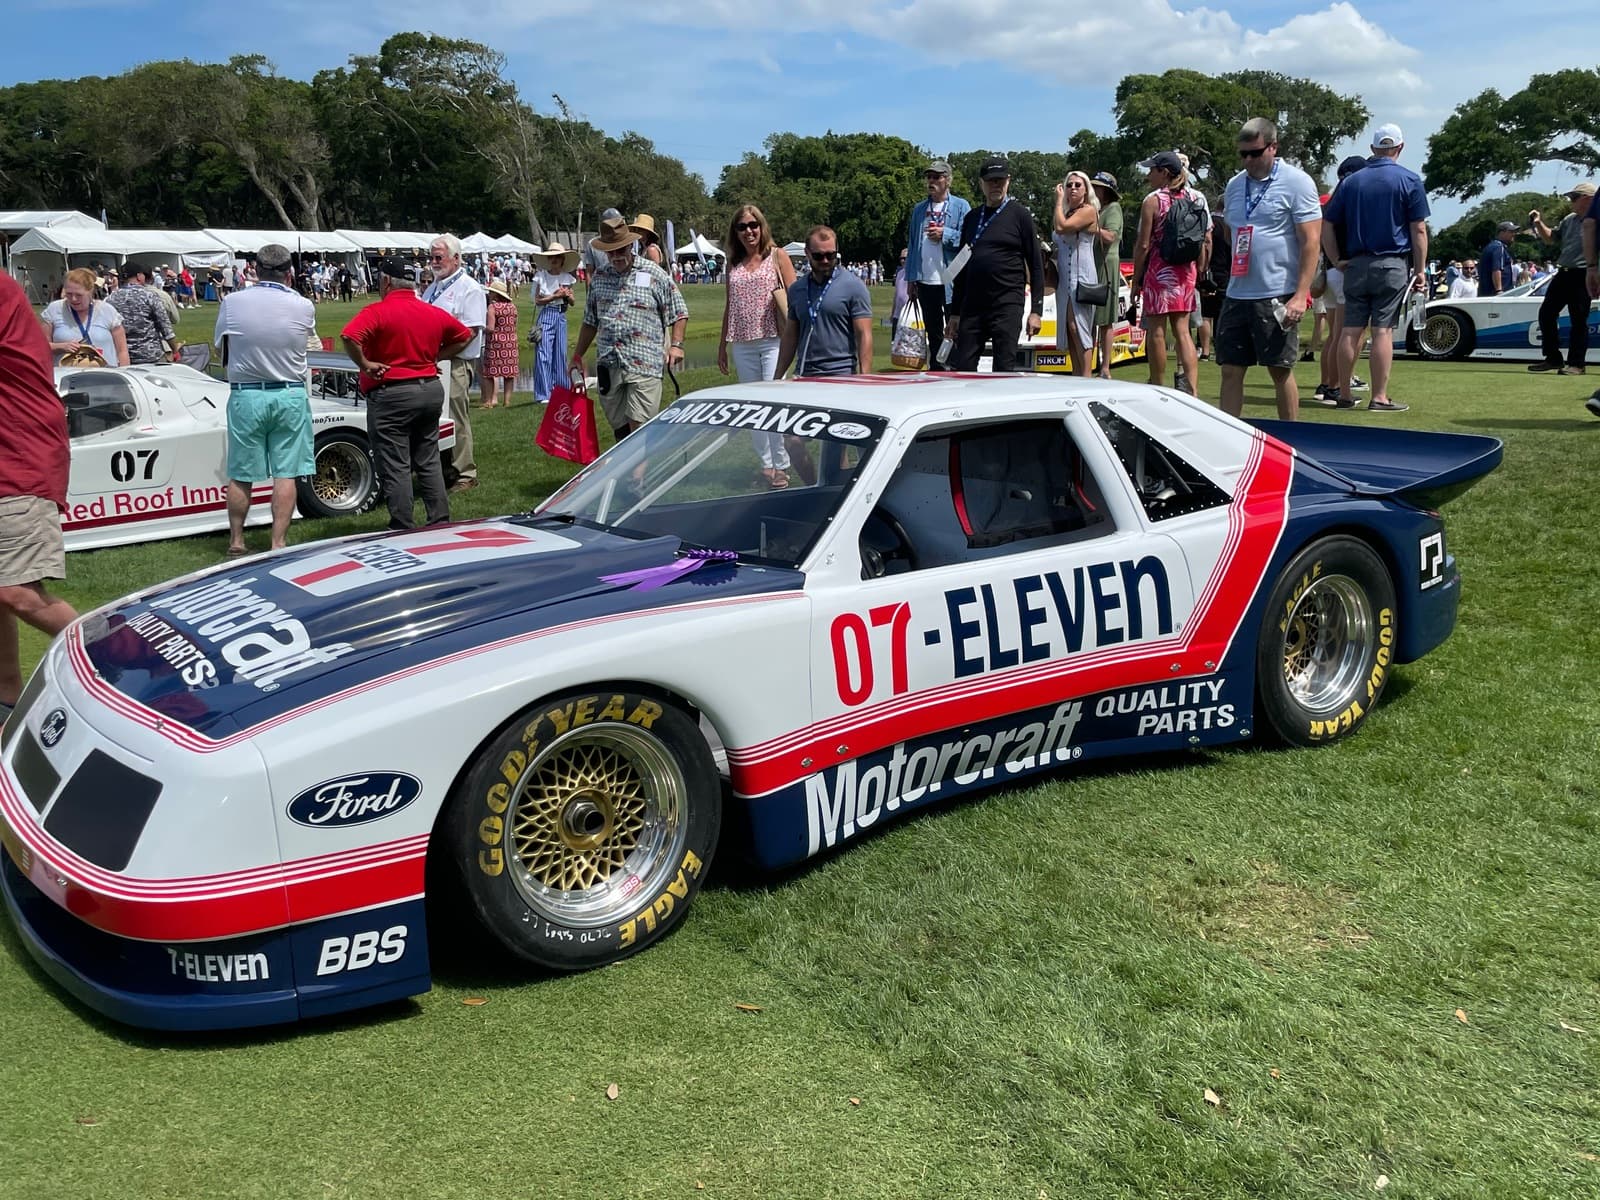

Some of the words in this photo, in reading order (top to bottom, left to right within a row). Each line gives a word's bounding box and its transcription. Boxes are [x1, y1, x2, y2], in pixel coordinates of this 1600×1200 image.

[668, 402, 831, 438] MUSTANG
[110, 449, 159, 482] 07
[114, 487, 175, 515] Roof
[182, 485, 228, 505] Inns
[149, 577, 355, 688] otorcraft
[154, 634, 217, 686] PARTS
[1095, 678, 1226, 718] QUALITY
[1137, 704, 1235, 737] PARTS
[41, 710, 65, 745] Ford
[308, 777, 402, 823] Ford
[479, 695, 663, 877] GOODYEAR
[805, 701, 1083, 858] Motorcraft
[617, 850, 703, 950] EAGLE
[316, 925, 408, 976] BBS
